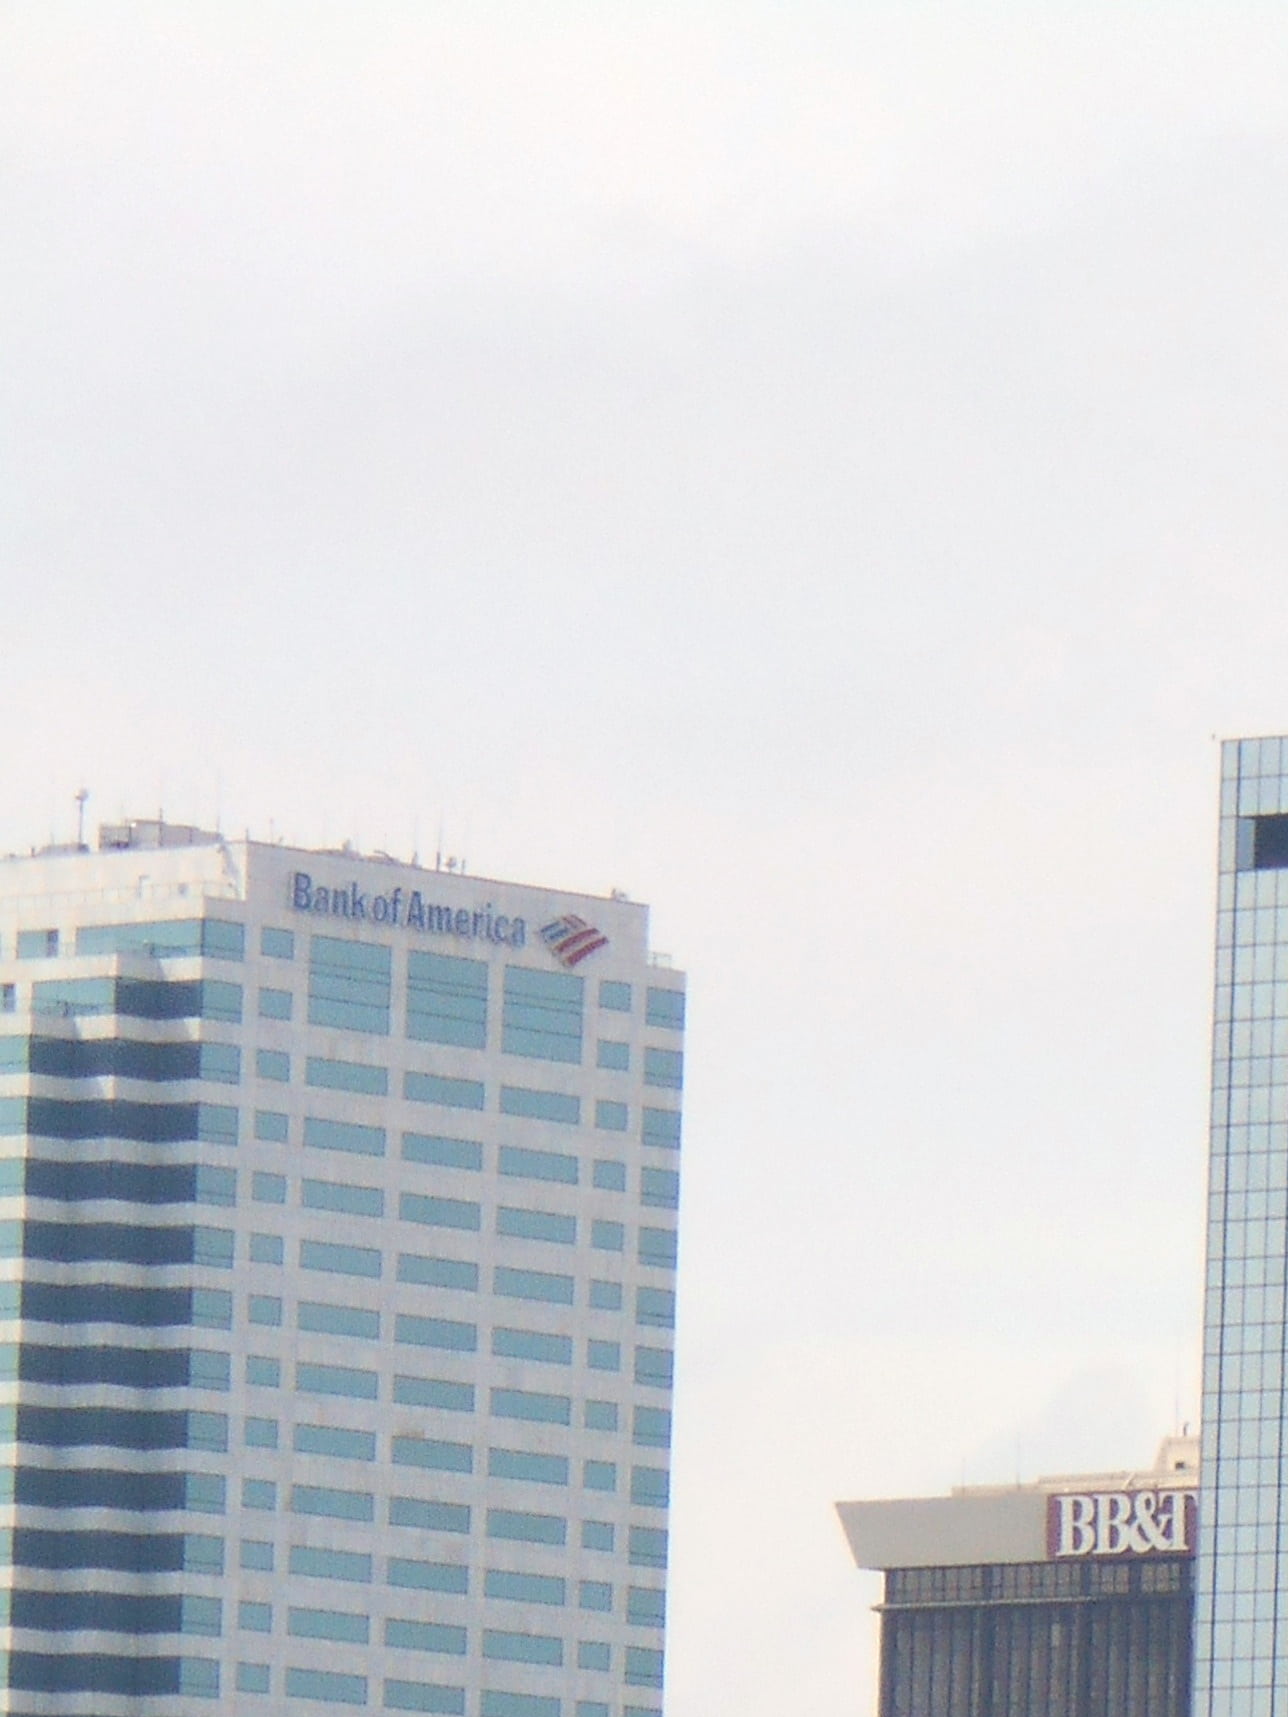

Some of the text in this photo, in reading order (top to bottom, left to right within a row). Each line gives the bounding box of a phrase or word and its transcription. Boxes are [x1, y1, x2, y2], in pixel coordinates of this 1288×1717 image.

[292, 872, 527, 947] Bank of America
[1056, 1490, 1199, 1556] BB&T
